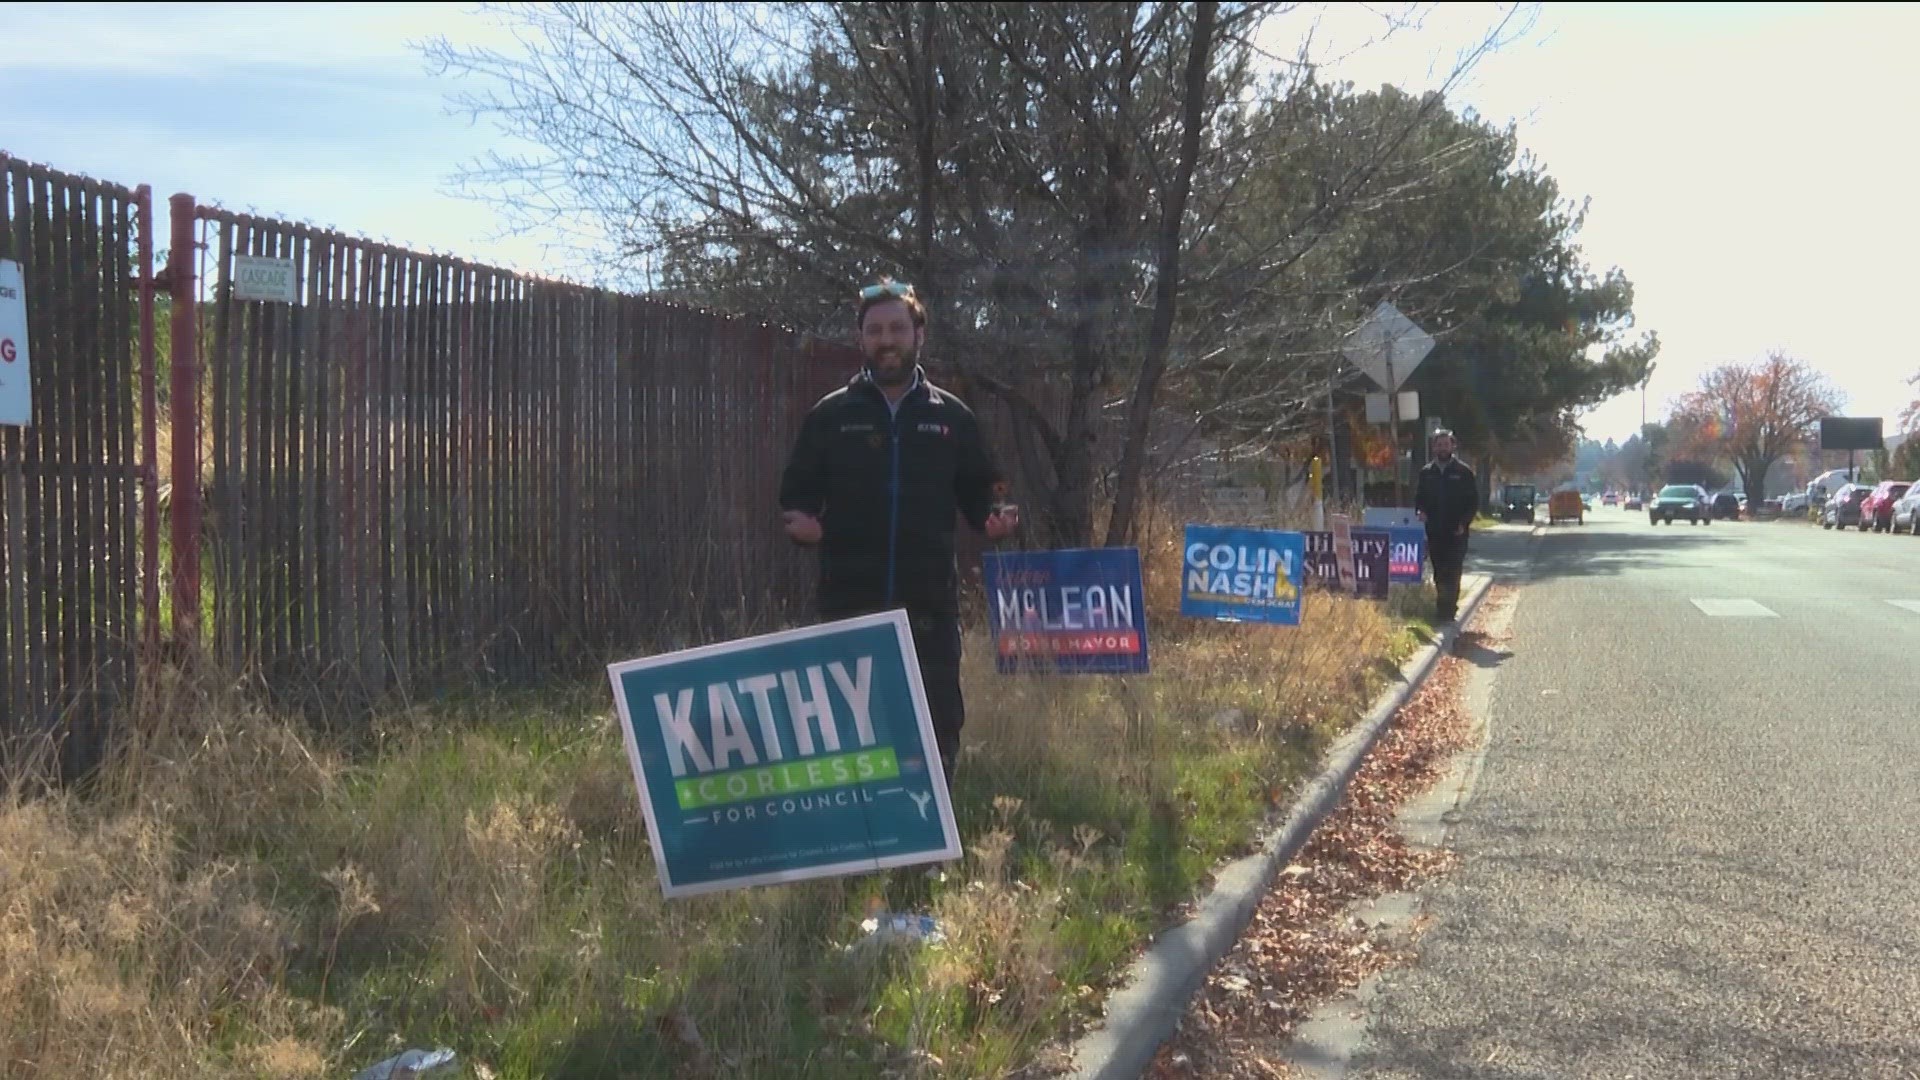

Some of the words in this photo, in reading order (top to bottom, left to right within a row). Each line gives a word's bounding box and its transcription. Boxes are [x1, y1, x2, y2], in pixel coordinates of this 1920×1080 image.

[241, 268, 288, 287] CASCADE
[1186, 542, 1293, 575] COLIN
[1304, 534, 1386, 558] Hiary
[1303, 559, 1369, 578] Smh
[1187, 570, 1275, 598] NASH
[1068, 636, 1130, 650] MAYOR
[653, 655, 876, 777] KATHY
[699, 754, 874, 801] CORLESS
[713, 806, 756, 824] FOR
[766, 788, 873, 816] COUNCIL
